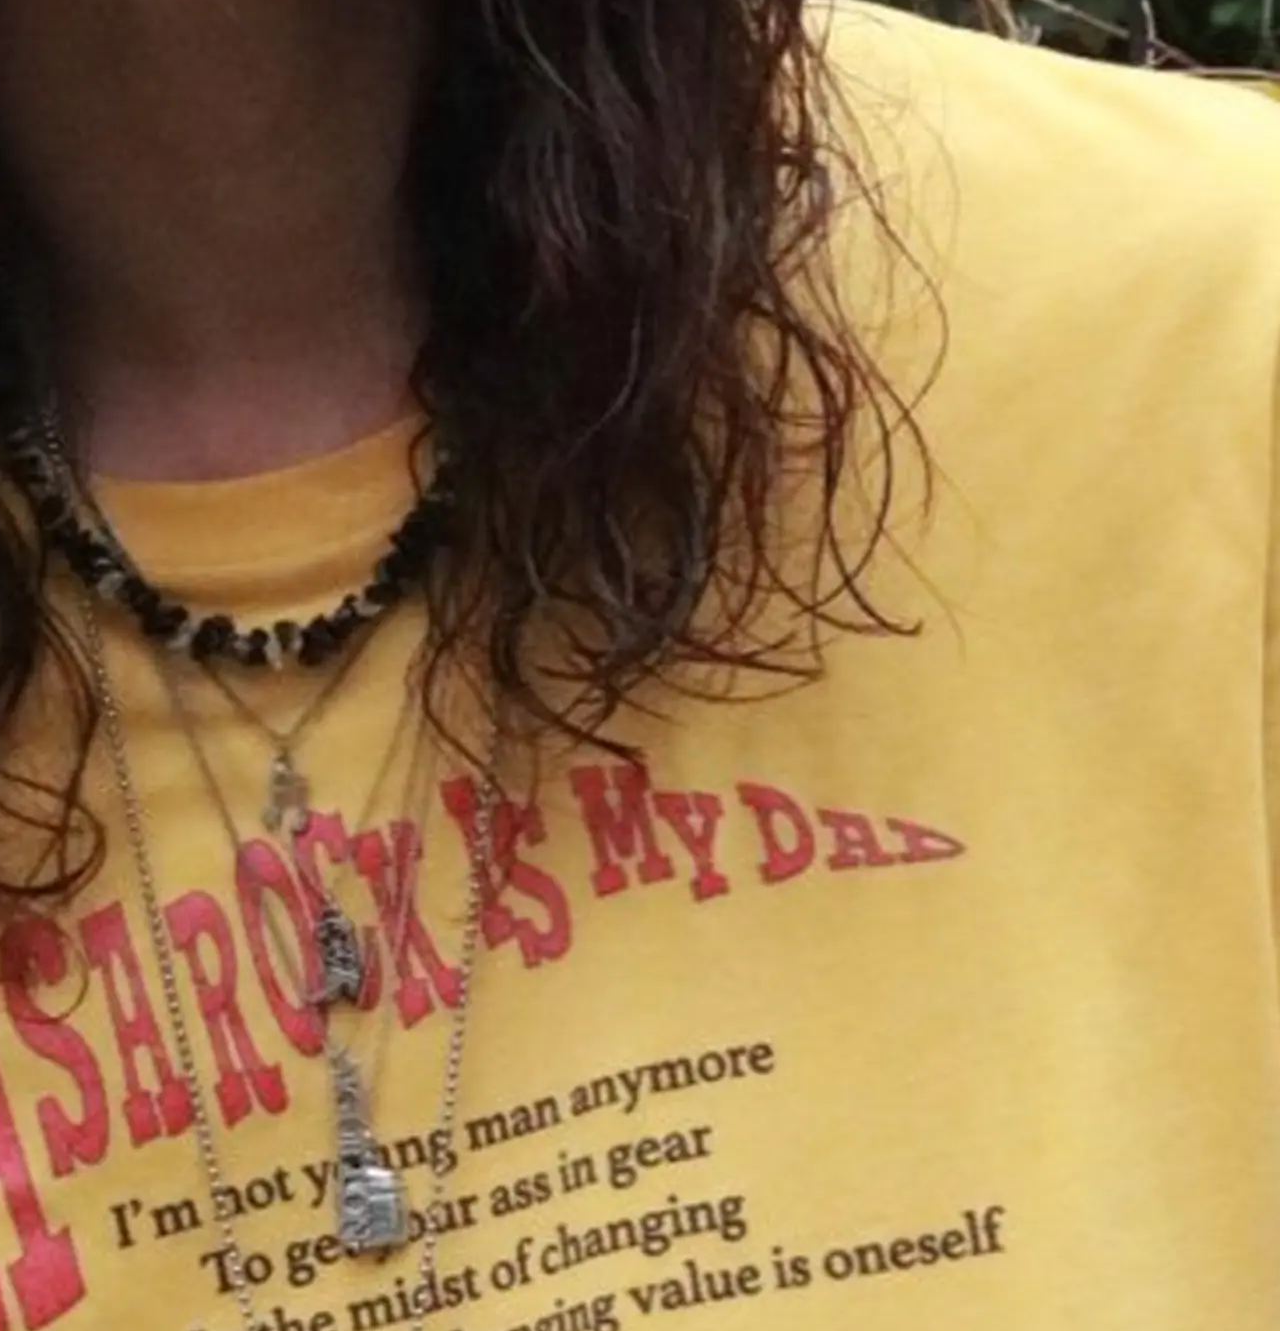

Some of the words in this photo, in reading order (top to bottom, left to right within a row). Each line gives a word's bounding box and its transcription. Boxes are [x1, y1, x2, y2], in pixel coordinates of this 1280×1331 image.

[439, 774, 572, 969] IS
[109, 1197, 203, 1249] I'm
[213, 1168, 295, 1222] not
[301, 1129, 458, 1208] yng
[464, 1095, 562, 1152] man
[569, 1041, 775, 1115] anymore
[199, 1243, 275, 1295] To
[286, 1234, 359, 1288] ge
[377, 1195, 480, 1266] our
[488, 1171, 553, 1217] ass
[558, 1150, 598, 1195] in
[606, 1125, 713, 1190] gear
[489, 1236, 534, 1292] of
[539, 1193, 747, 1275] changing
[628, 1260, 762, 1317] value
[773, 1245, 812, 1290] is
[822, 1205, 1006, 1281] oneself
